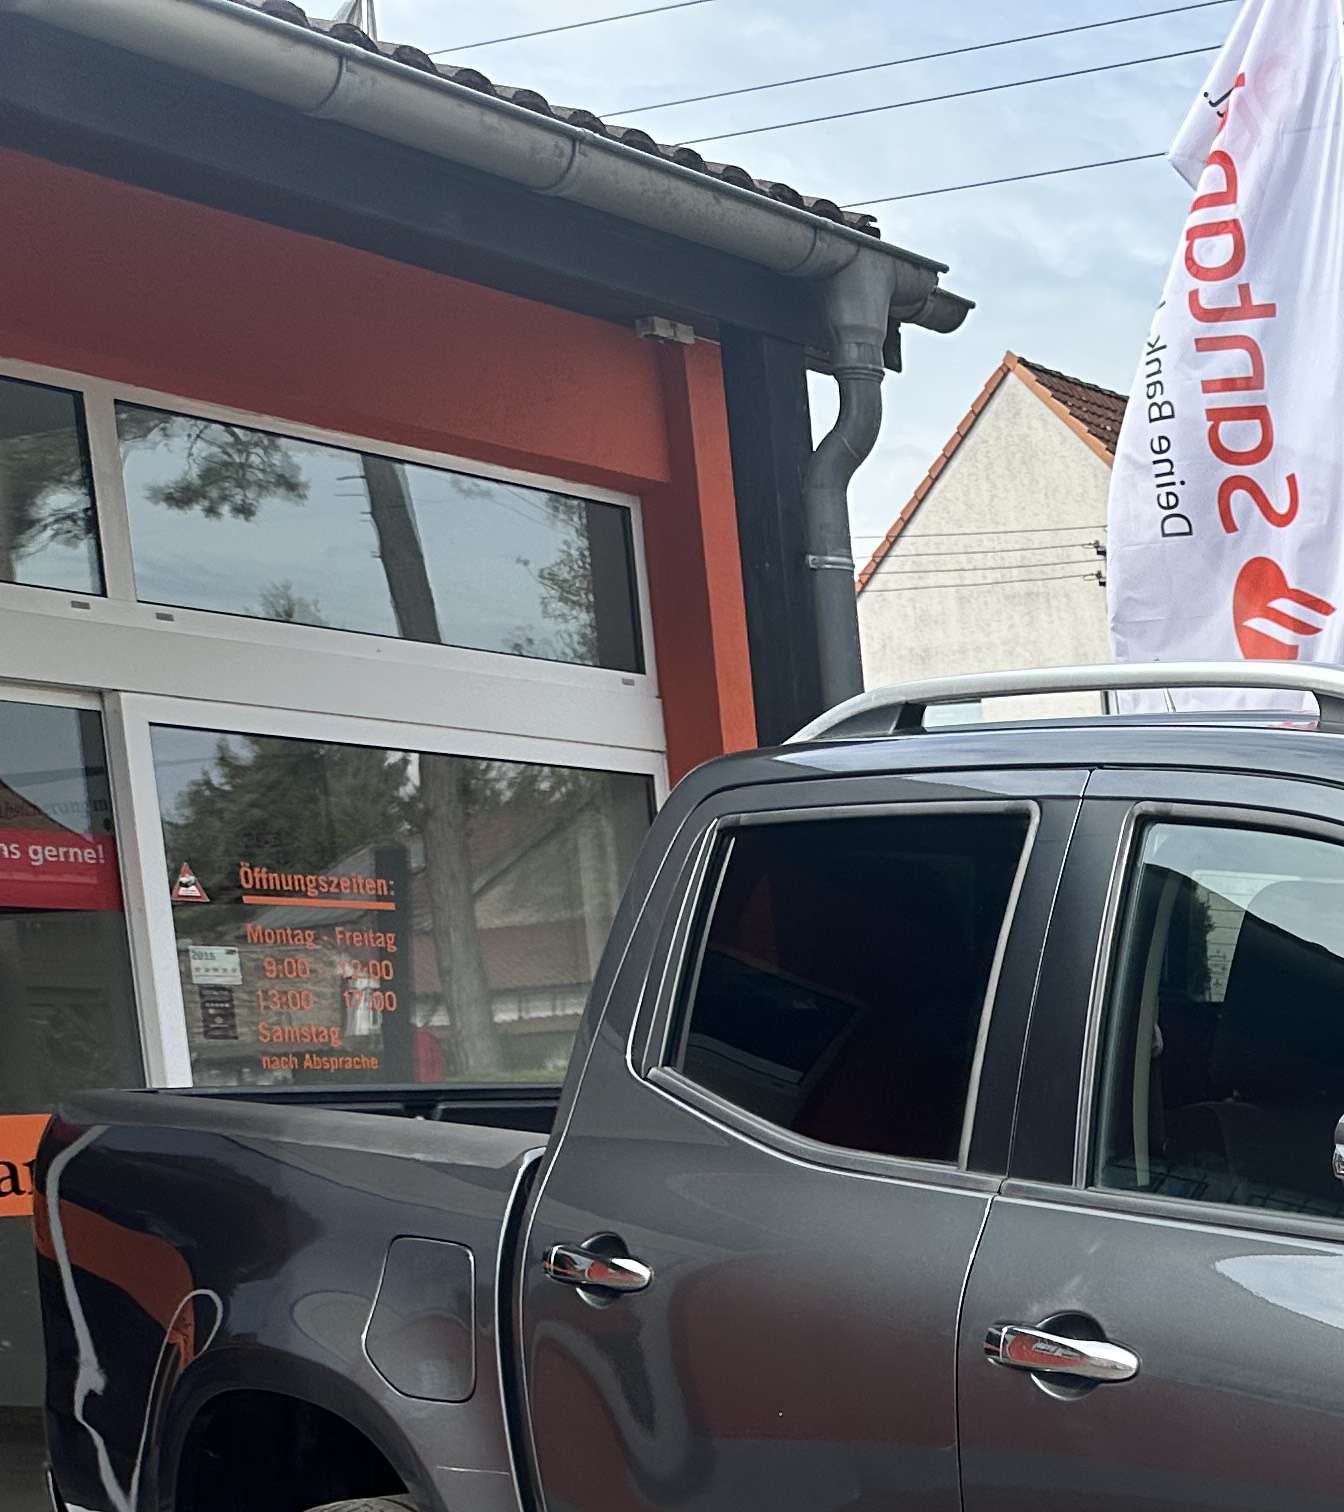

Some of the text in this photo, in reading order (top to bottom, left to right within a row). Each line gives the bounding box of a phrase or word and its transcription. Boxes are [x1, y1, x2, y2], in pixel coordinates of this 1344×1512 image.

[28, 844, 105, 866] gerne!
[240, 861, 395, 897] Öffnungszeiten:
[246, 922, 318, 950] Montag
[335, 927, 397, 953] Freitag
[263, 956, 310, 979] 9:00
[256, 989, 315, 1011] 13:00
[257, 1022, 342, 1046] Samstag
[262, 1054, 379, 1072] nach Absprache
